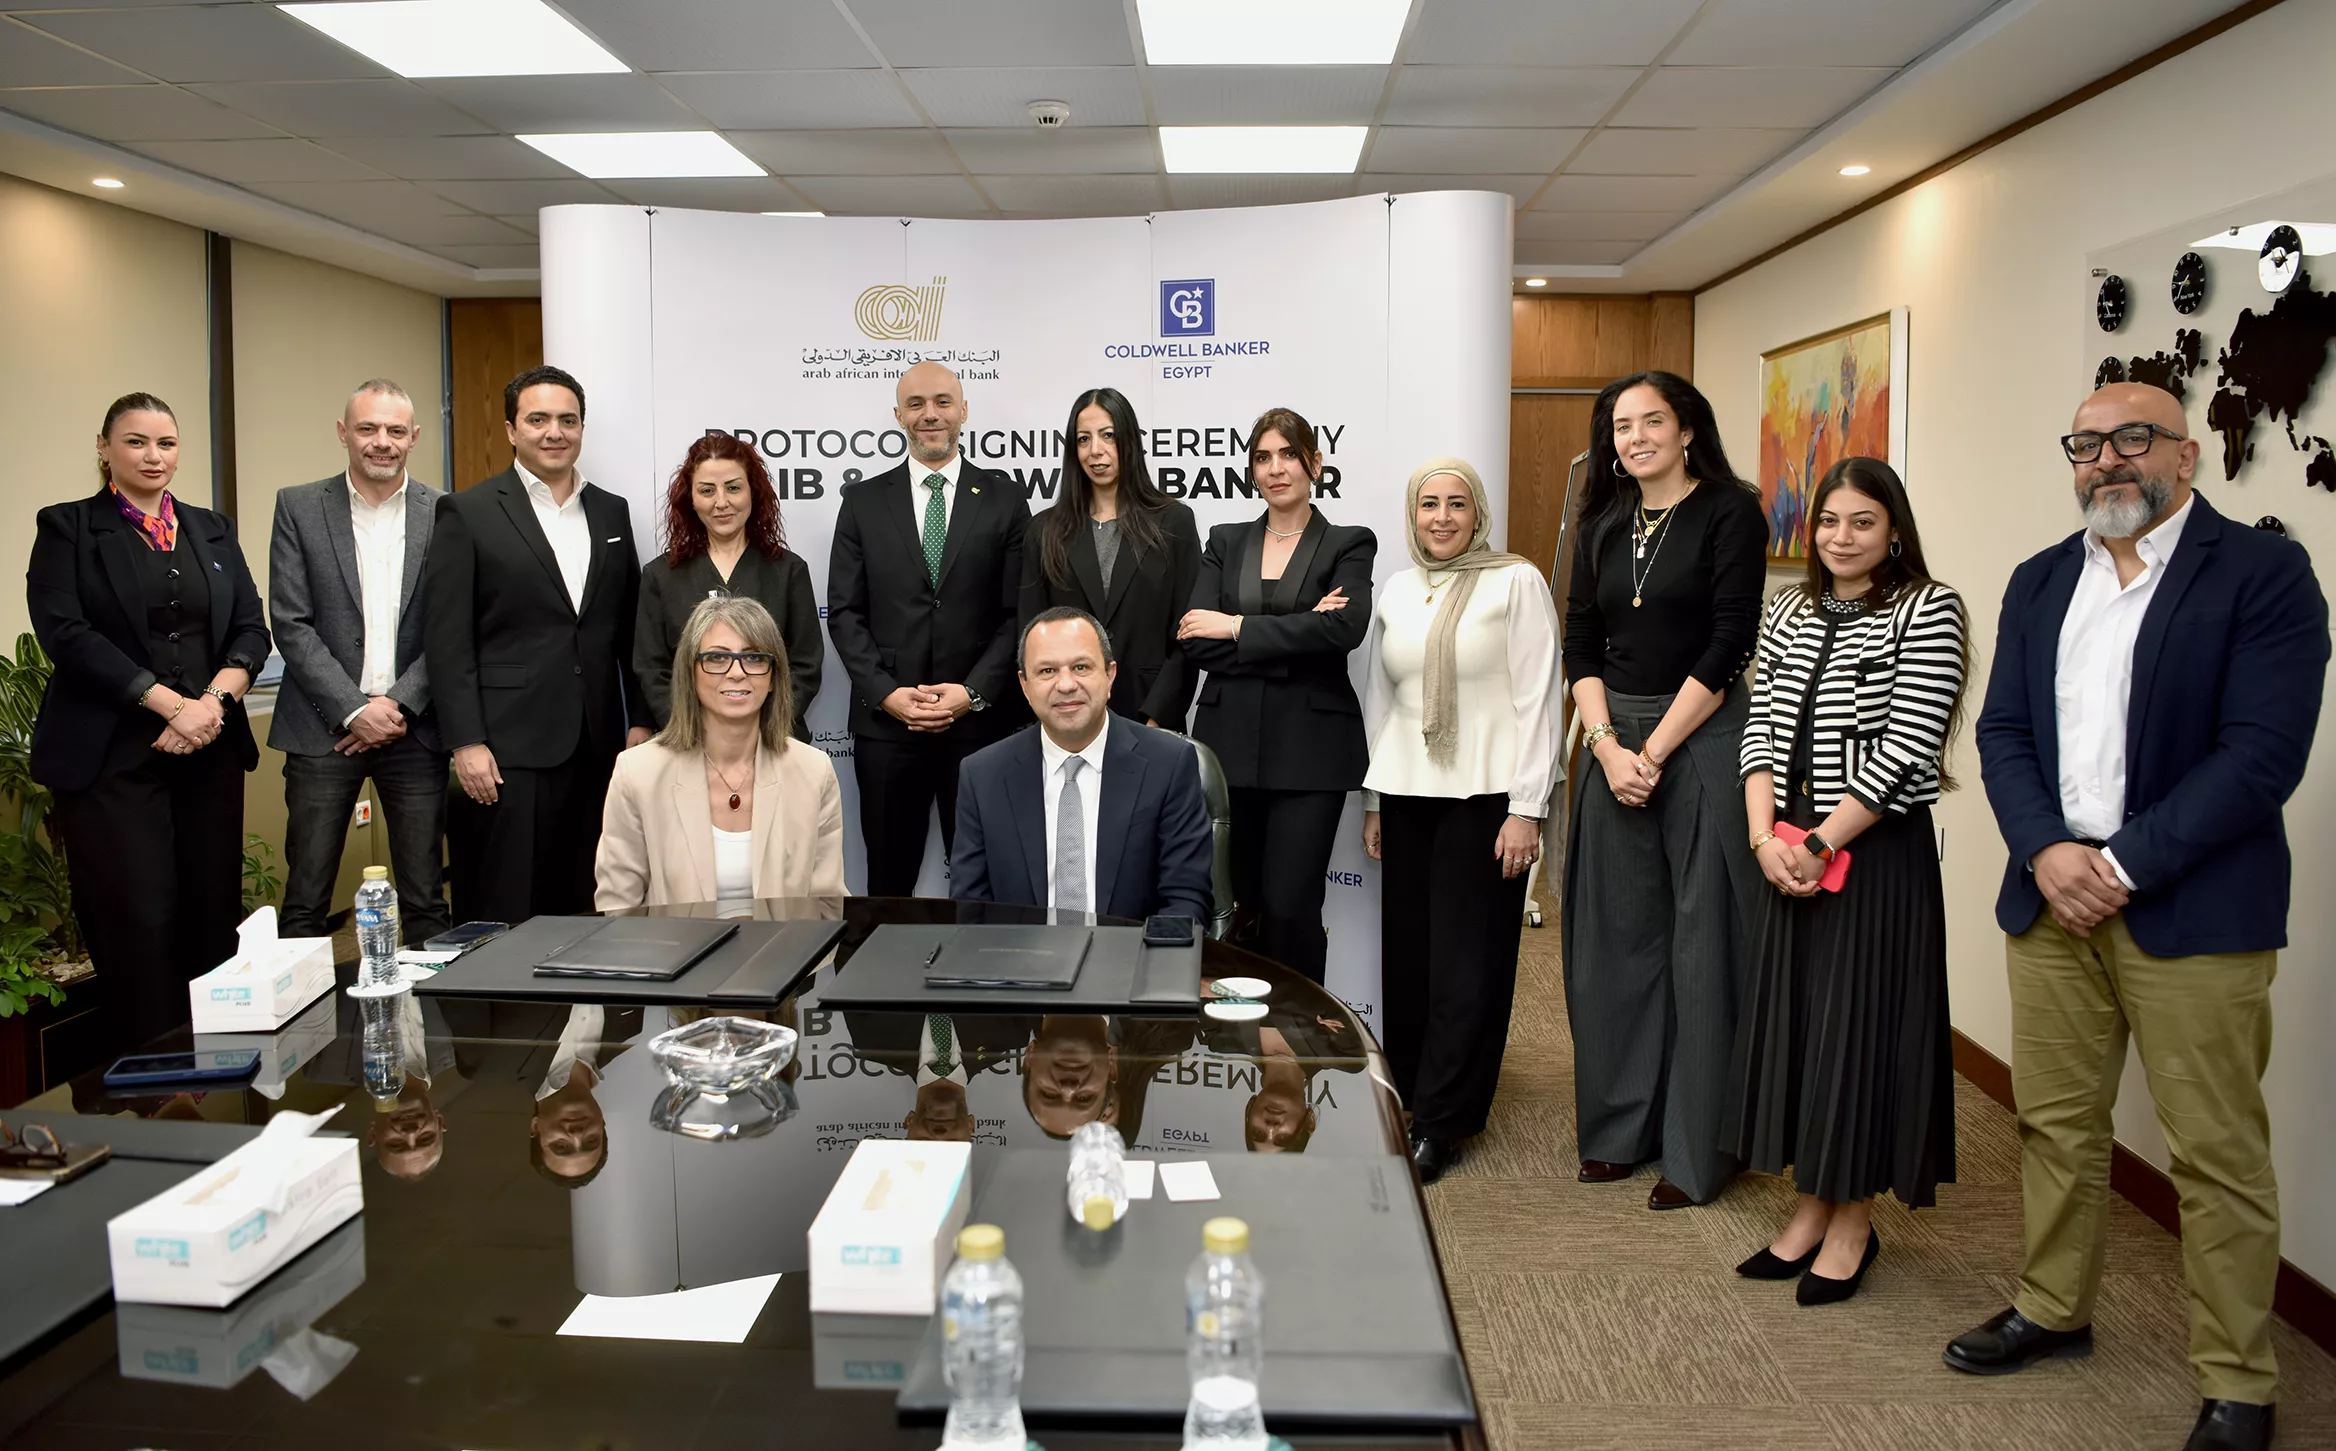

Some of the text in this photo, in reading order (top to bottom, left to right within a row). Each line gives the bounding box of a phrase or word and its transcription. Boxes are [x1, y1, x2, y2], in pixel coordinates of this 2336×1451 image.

[1104, 341, 1270, 358] COLDWELL BANKER
[802, 368, 831, 378] arab
[835, 368, 879, 378] african
[969, 369, 1000, 379] bank
[1163, 366, 1212, 378] EGYPT
[705, 425, 1345, 459] ROTOCO SIGNIN EREMY
[779, 468, 824, 500] IB
[1158, 465, 1341, 499] BANR
[826, 748, 855, 758] bank
[1326, 871, 1363, 888] NKER
